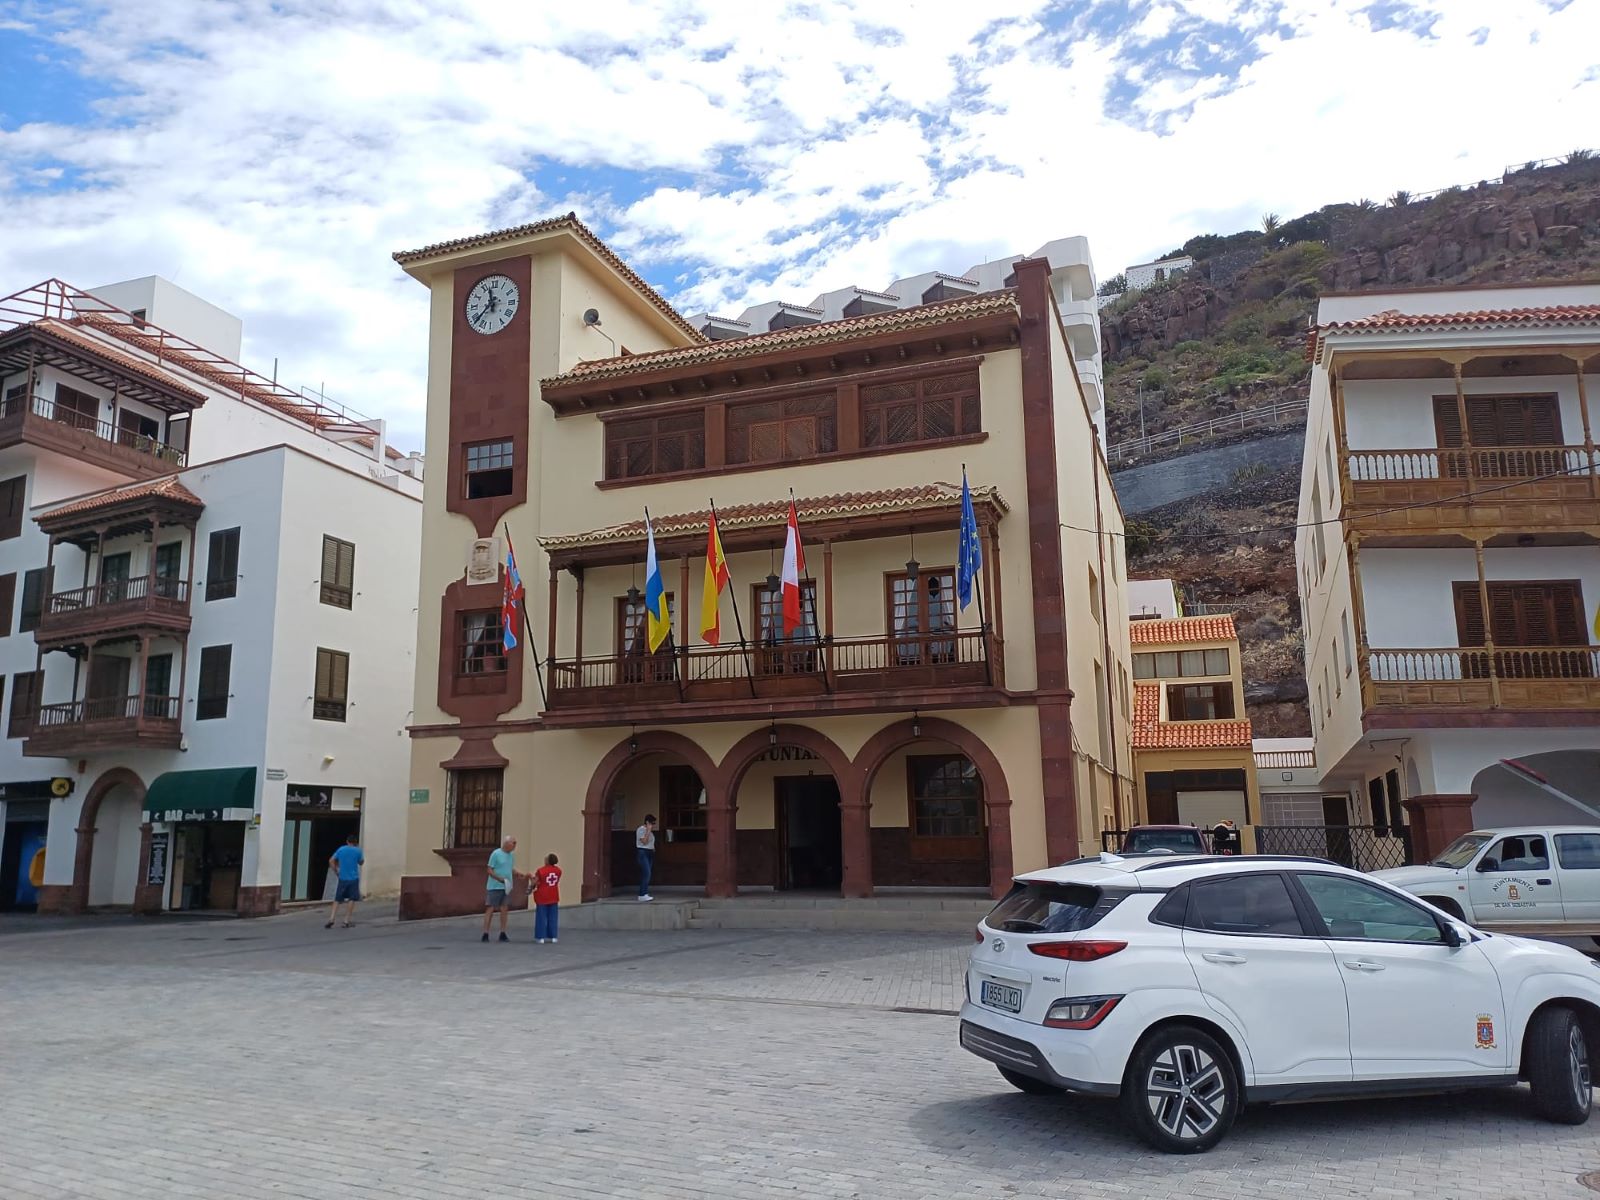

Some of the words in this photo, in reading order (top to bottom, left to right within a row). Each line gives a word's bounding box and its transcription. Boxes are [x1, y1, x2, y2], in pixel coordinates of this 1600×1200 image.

[164, 809, 183, 821] BAR
[1492, 878, 1534, 892] AYUNTAMIENTO
[986, 984, 1002, 1002] 1855
[1003, 988, 1018, 1006] LXD
